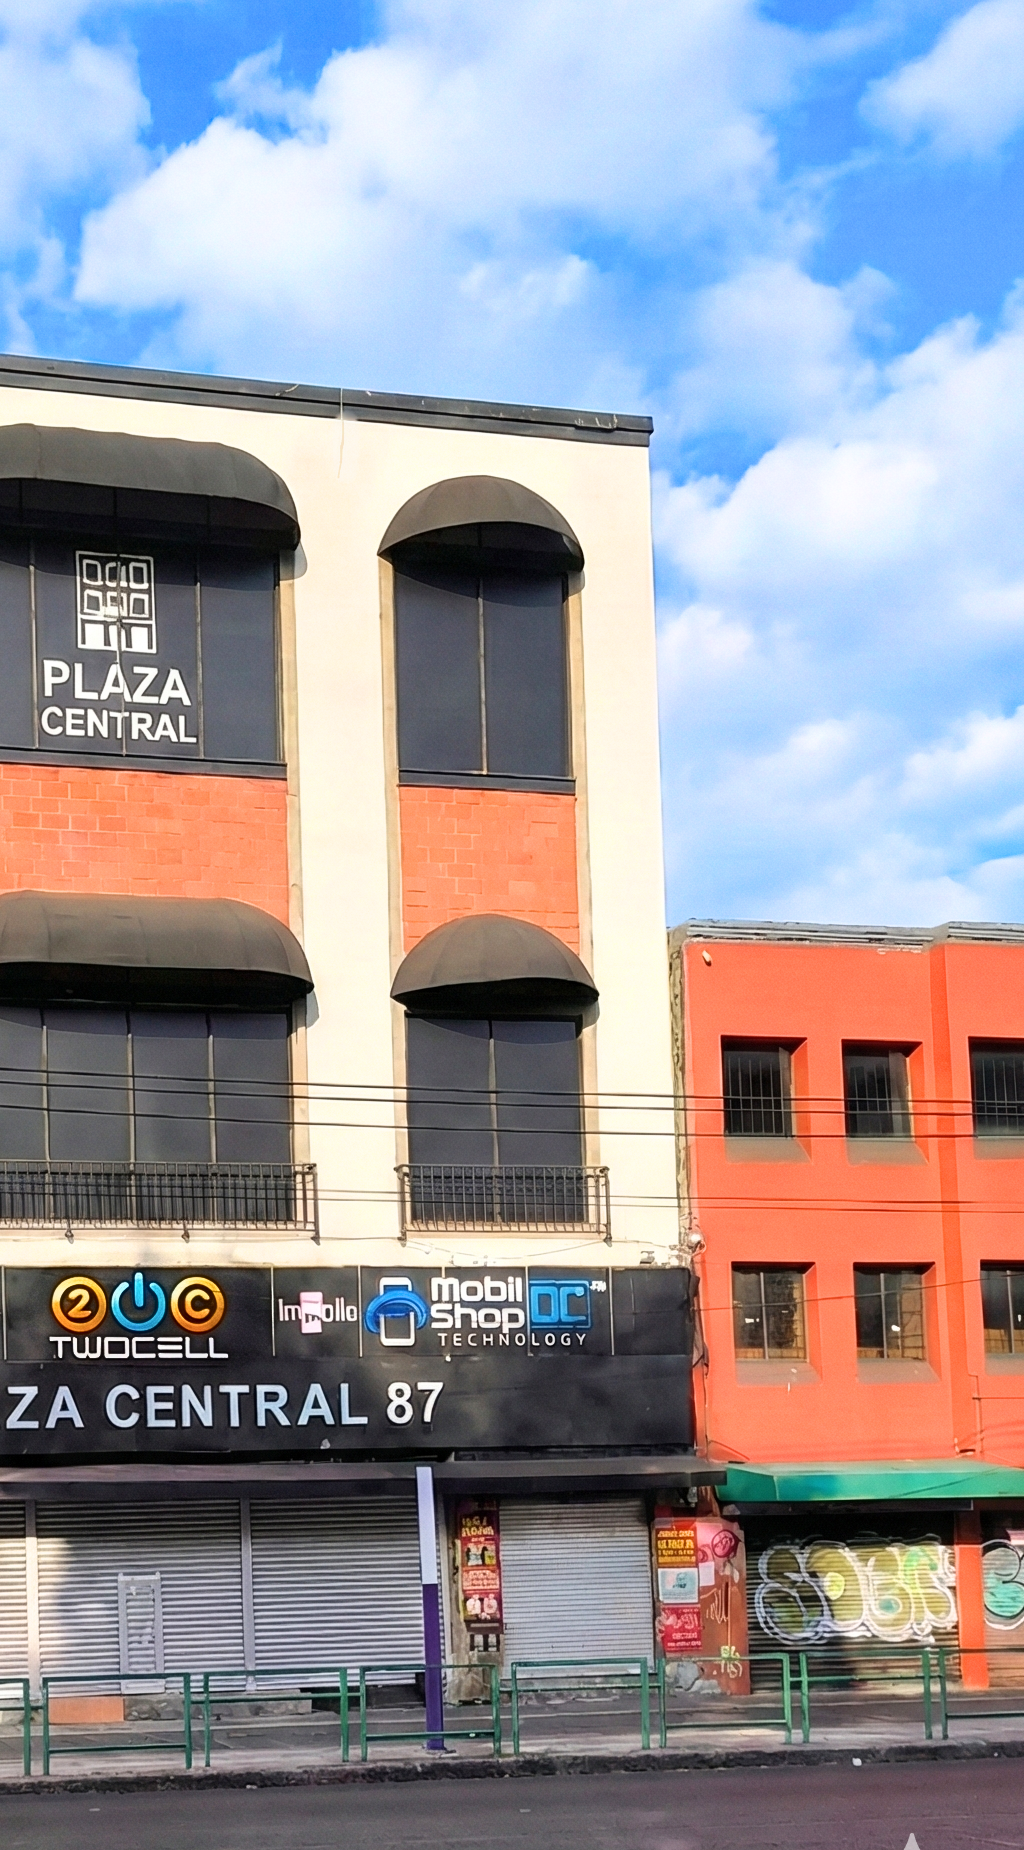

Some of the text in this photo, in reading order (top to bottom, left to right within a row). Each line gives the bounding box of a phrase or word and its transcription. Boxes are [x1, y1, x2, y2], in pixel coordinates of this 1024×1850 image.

[43, 659, 192, 706] PLAZA
[41, 706, 198, 743] CENTRAL
[430, 1303, 525, 1334] Shop
[49, 1336, 229, 1359] TWOCELL
[437, 1333, 587, 1346] TECHNOLOGY
[105, 1382, 369, 1428] CENTRAL
[386, 1381, 445, 1425] 87
